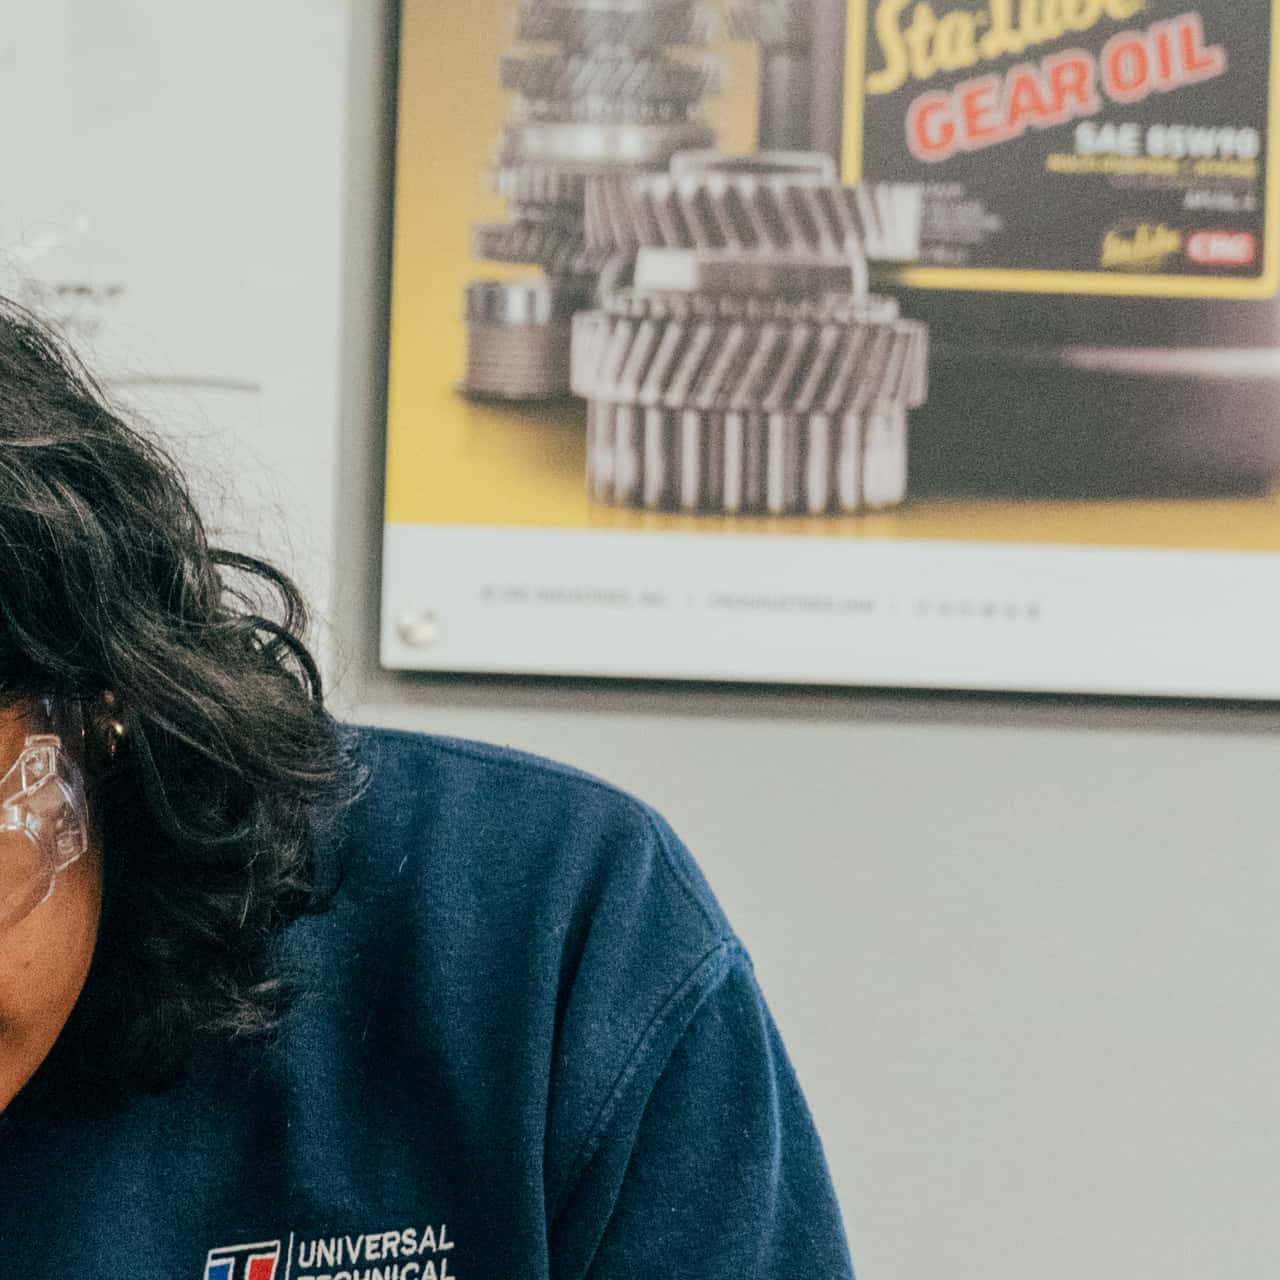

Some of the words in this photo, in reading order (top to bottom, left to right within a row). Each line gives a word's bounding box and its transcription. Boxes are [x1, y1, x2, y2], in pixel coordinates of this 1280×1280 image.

[906, 48, 1101, 162] GEAR
[1100, 11, 1227, 103] OIL
[297, 1223, 454, 1269] UNIVERSAL
